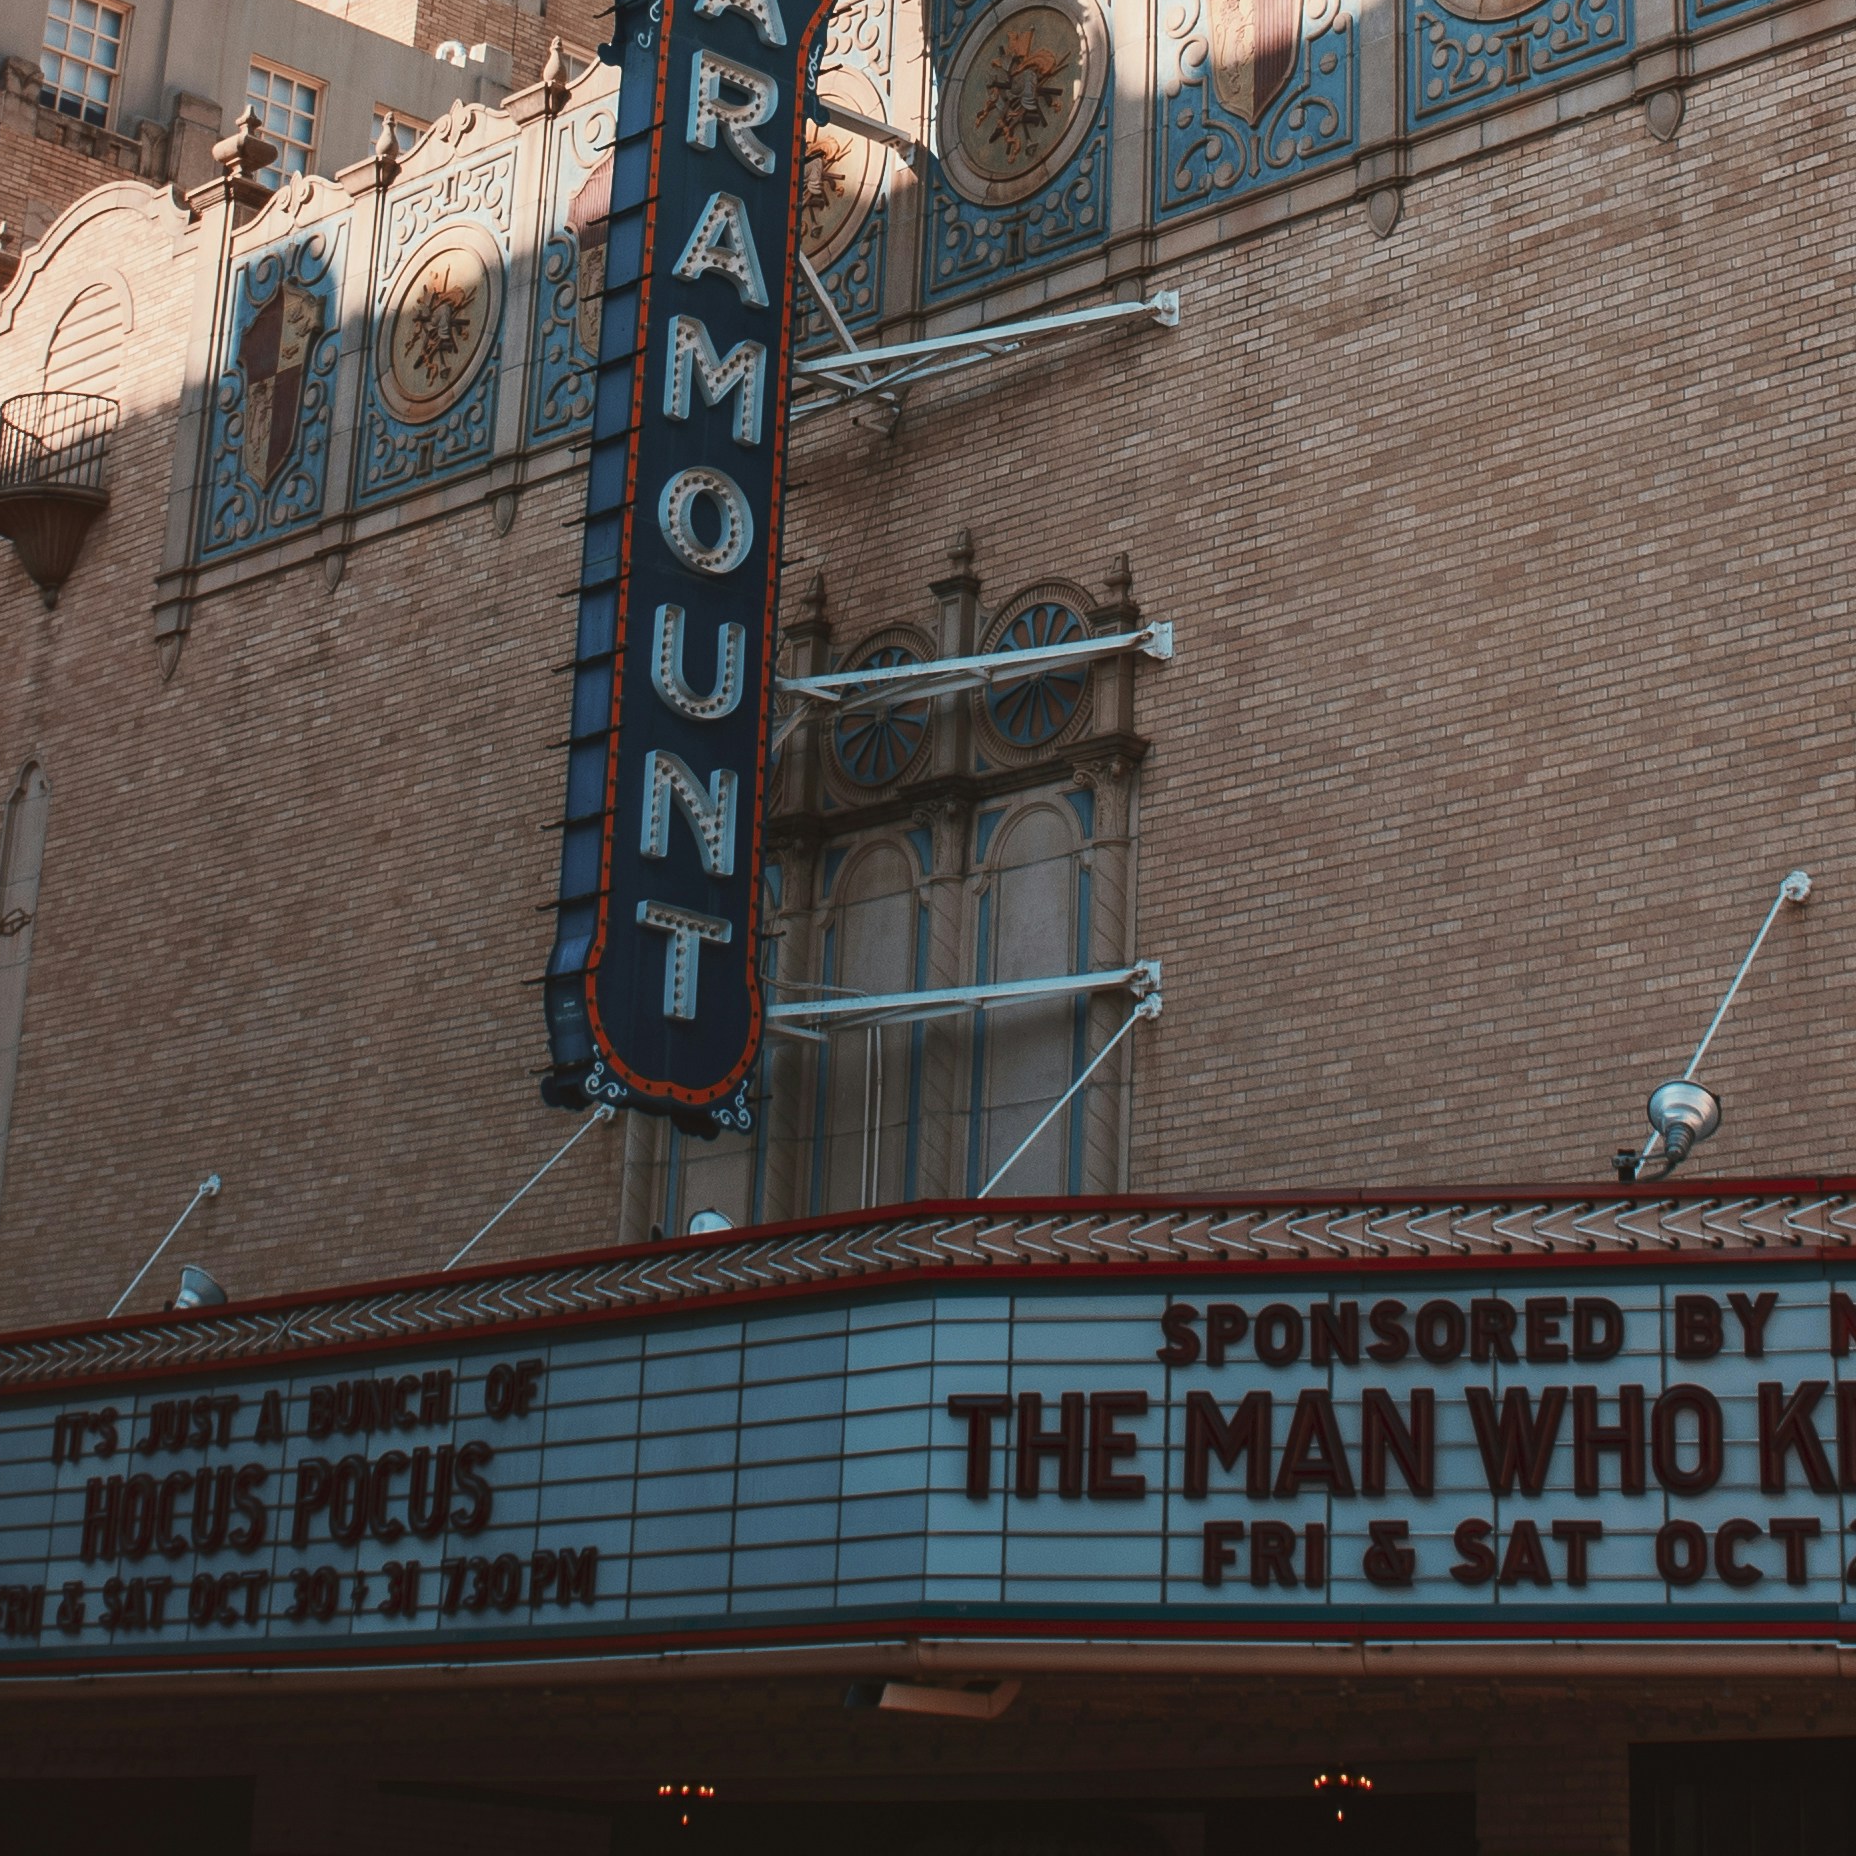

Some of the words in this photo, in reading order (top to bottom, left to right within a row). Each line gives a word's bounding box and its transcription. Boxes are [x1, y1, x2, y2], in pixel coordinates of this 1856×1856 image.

[1156, 1295, 1625, 1368] SPONSORED
[1673, 1290, 1779, 1360] BY
[51, 1406, 119, 1465] IT'S
[138, 1395, 240, 1456] JUST
[255, 1389, 284, 1444] A
[306, 1369, 453, 1441] BUNCH
[484, 1358, 543, 1420] OF
[947, 1390, 1149, 1502] THE
[1182, 1385, 1438, 1501] MAN
[1464, 1382, 1725, 1500] WHO
[79, 1462, 270, 1564] HOCUS
[291, 1440, 495, 1550] POCUS
[56, 1580, 86, 1634] &
[98, 1575, 173, 1633] SAT
[187, 1568, 269, 1628] OCT
[284, 1565, 340, 1624] 30
[380, 1559, 422, 1619] 31
[441, 1554, 522, 1617] 730
[529, 1545, 599, 1610] PM
[1201, 1519, 1328, 1590] FRI
[1361, 1519, 1417, 1590] &
[1449, 1518, 1605, 1589] SAT
[1654, 1517, 1824, 1589] OCT
